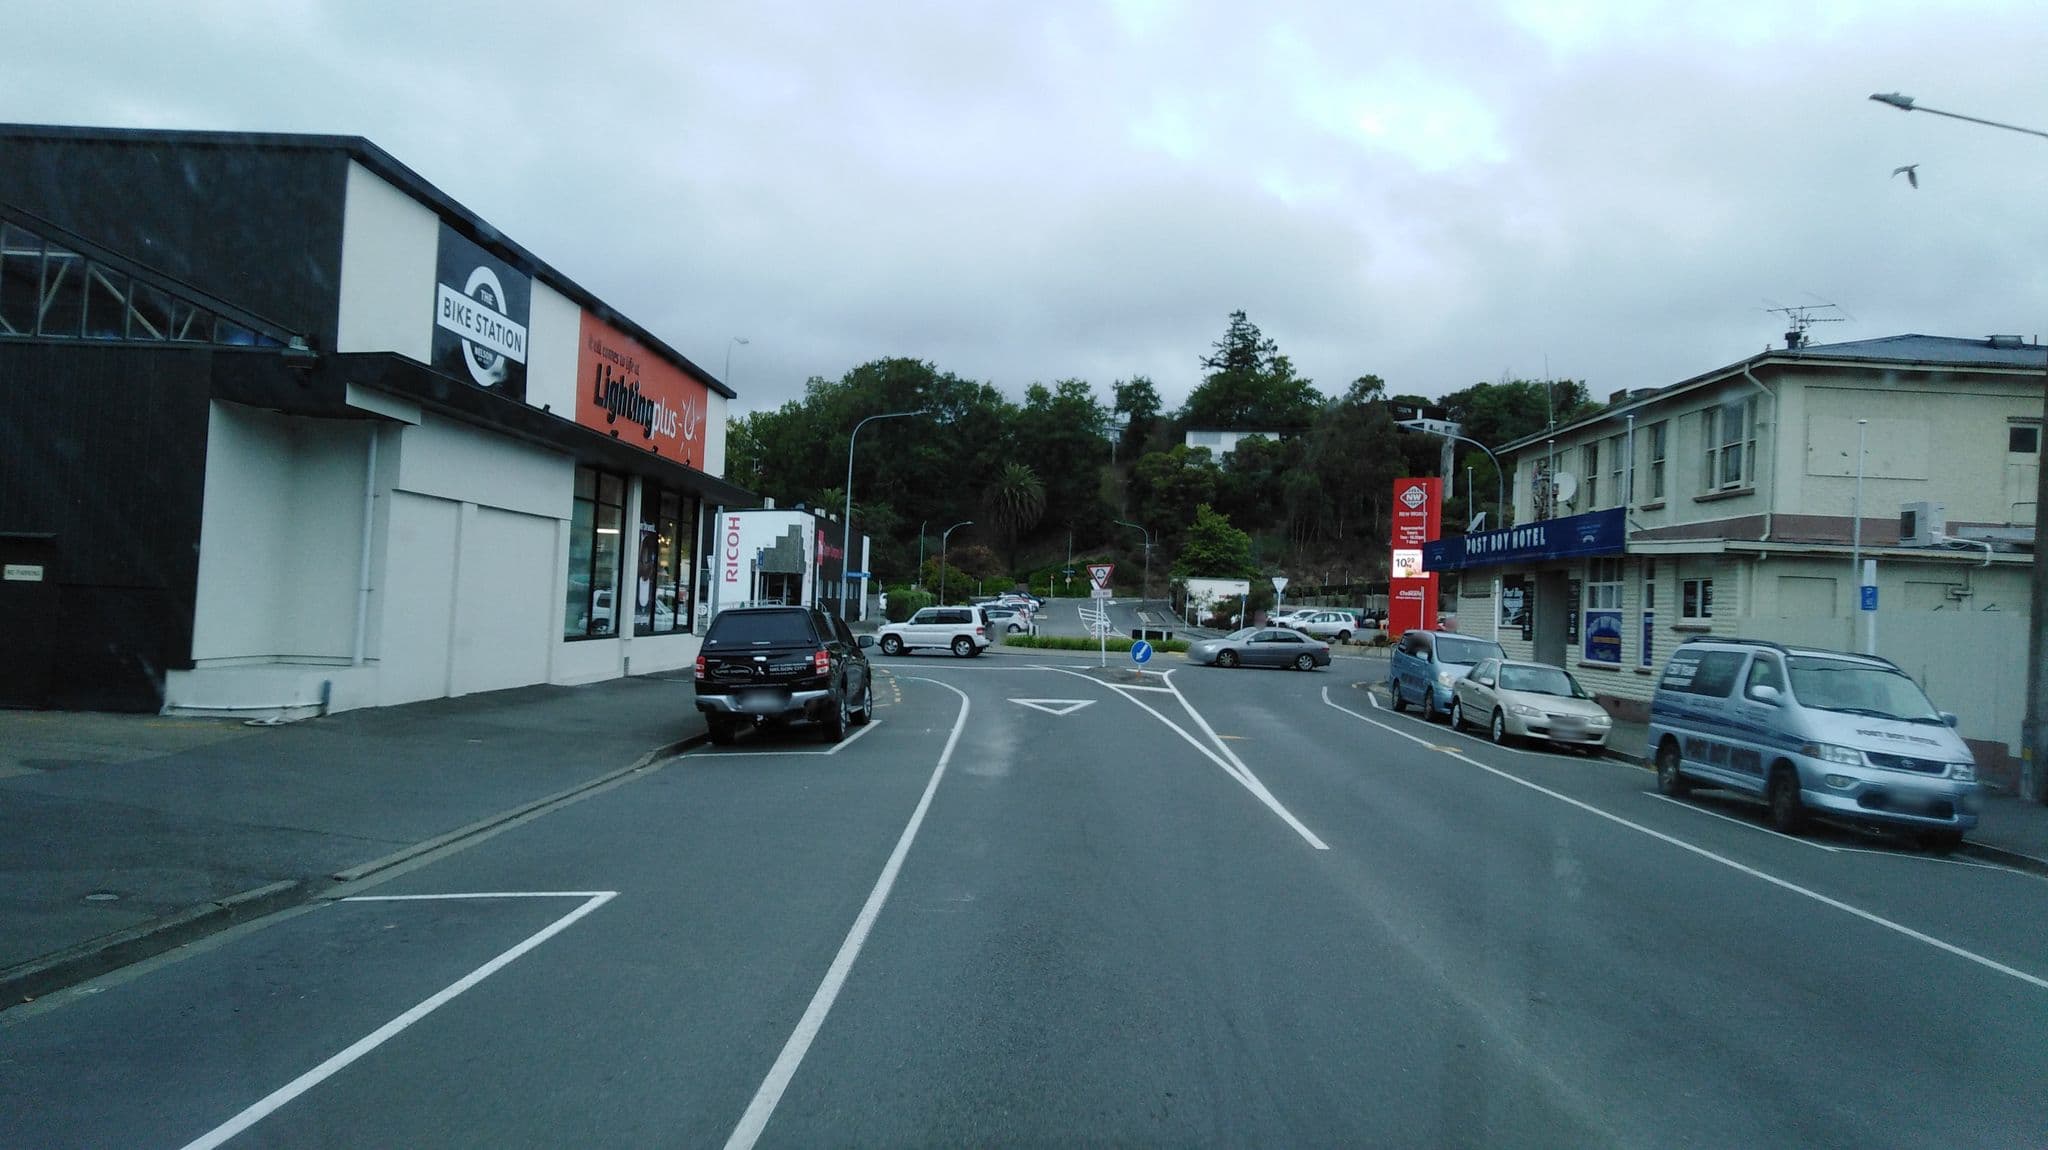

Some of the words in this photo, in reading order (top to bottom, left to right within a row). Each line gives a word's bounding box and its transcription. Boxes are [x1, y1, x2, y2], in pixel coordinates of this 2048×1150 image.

[443, 296, 472, 329] BIKE
[475, 313, 522, 353] STATION
[725, 517, 740, 582] RICOH
[1466, 536, 1487, 555] POST
[1490, 532, 1509, 551] BOY
[1512, 526, 1546, 549] HOTEL
